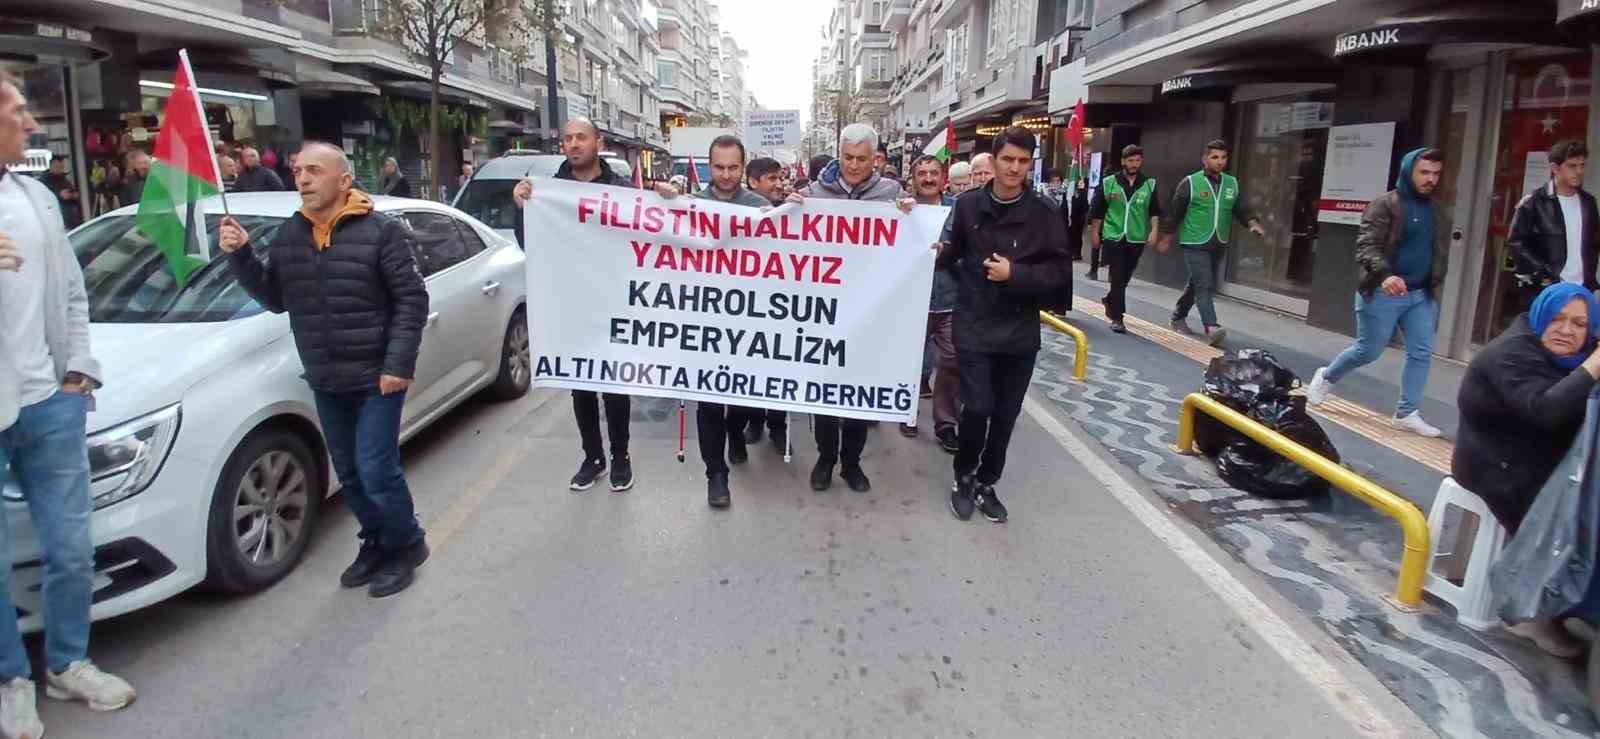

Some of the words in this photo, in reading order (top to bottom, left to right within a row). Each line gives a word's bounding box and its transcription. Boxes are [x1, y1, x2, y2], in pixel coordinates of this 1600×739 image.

[578, 192, 721, 239] FİLİSTİN
[729, 212, 898, 246] HALKININ
[630, 240, 843, 285] YANINDAYIZ
[628, 280, 838, 326] KAHROLSUN
[610, 318, 847, 367] EMPERYALİZM
[535, 356, 594, 380] ALTI
[600, 359, 690, 389] NOKTA
[697, 364, 799, 401] KÖRLER
[805, 380, 912, 411] DERNEĞ
